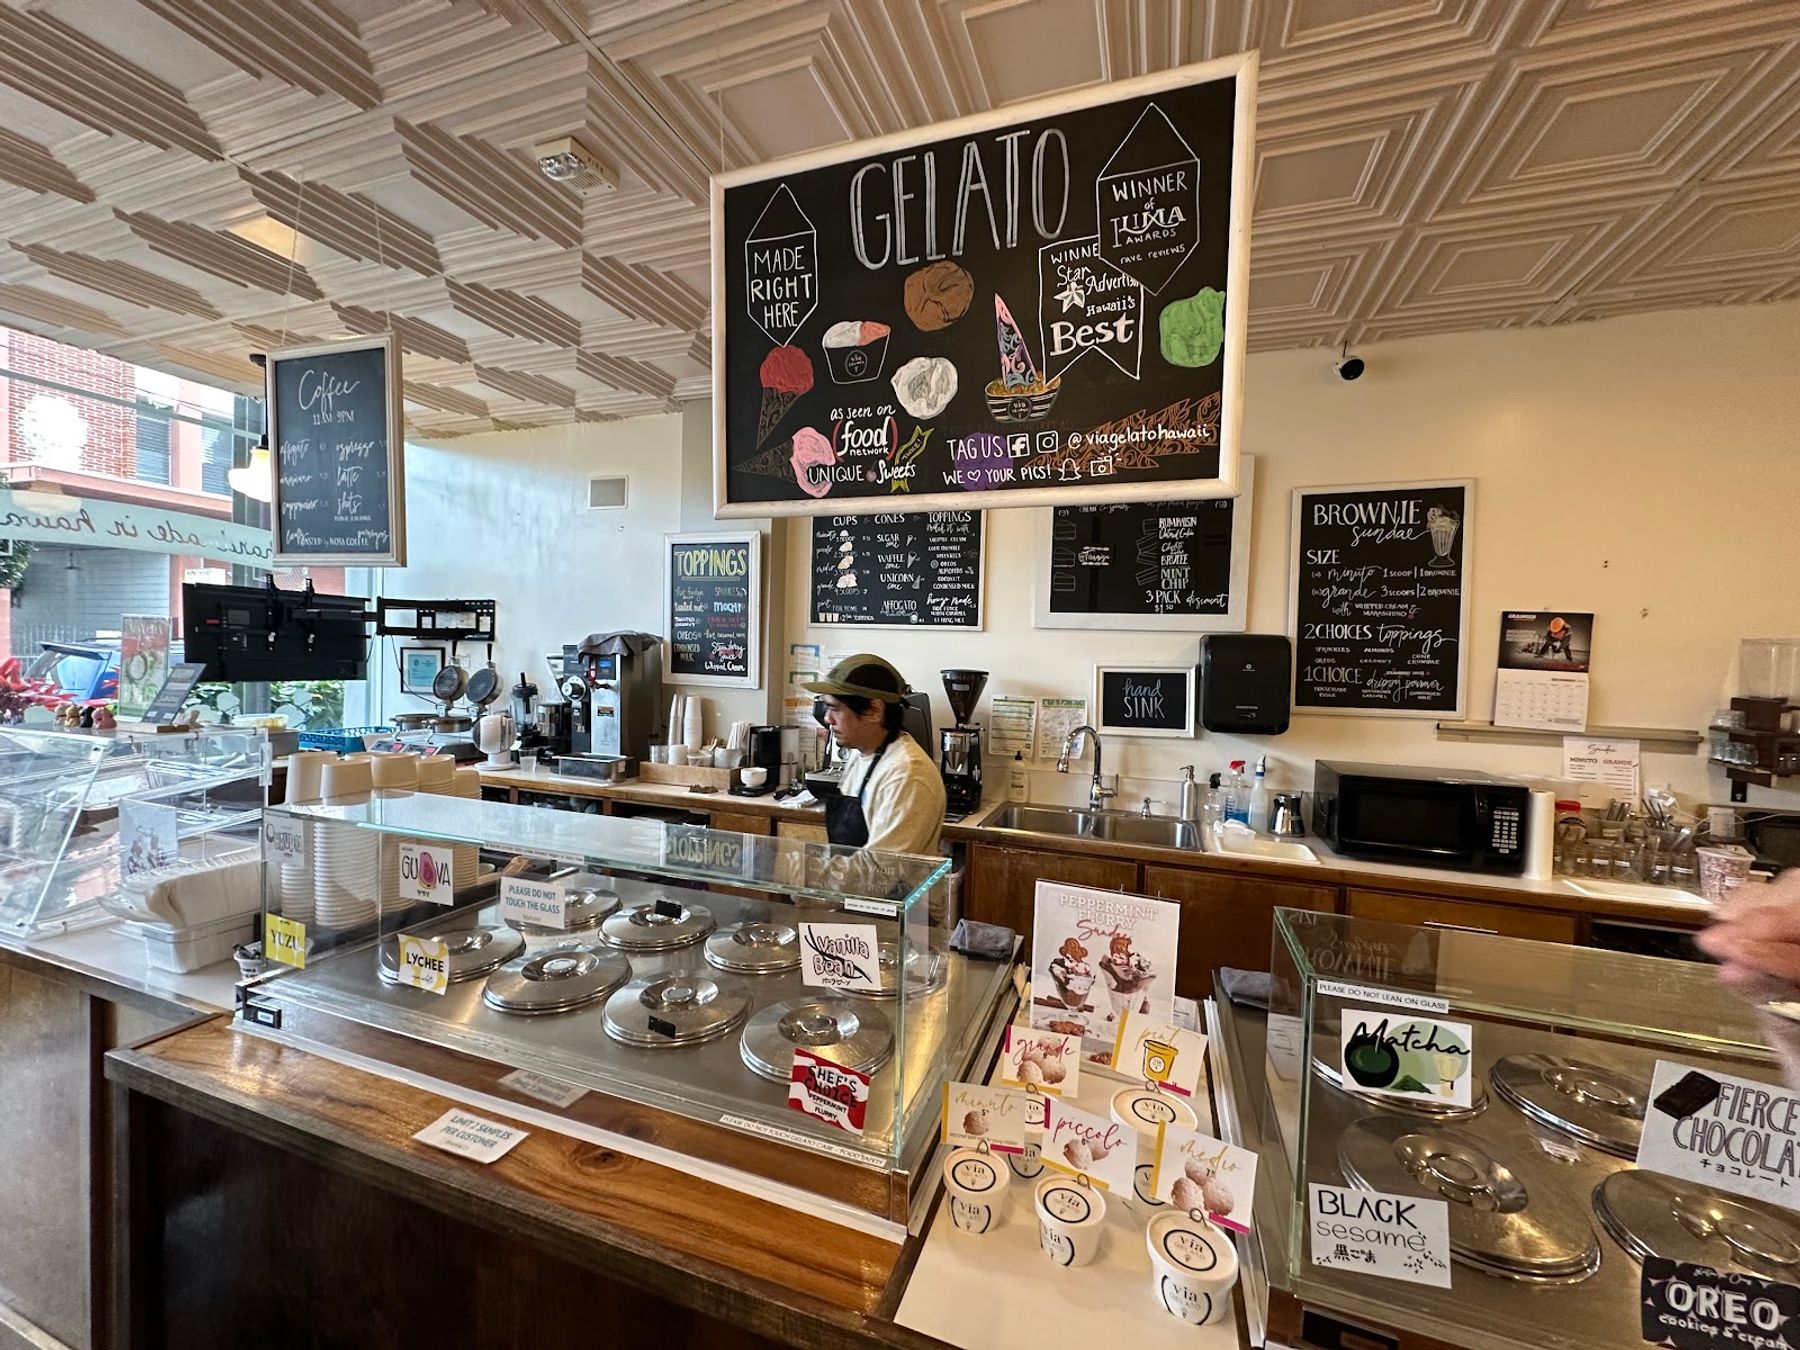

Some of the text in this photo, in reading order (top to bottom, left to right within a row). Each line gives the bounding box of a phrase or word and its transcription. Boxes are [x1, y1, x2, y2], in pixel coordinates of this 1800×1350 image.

[1112, 171, 1188, 202] WINNER
[850, 128, 1071, 270] GELATO
[1144, 197, 1156, 210] of
[1125, 229, 1177, 246] AWARDS
[754, 246, 805, 275] MADE
[1120, 243, 1187, 266] rave reviews
[751, 273, 813, 303] RIGHT
[1056, 265, 1092, 288] Star
[763, 301, 800, 330] HERE
[1085, 294, 1136, 318] Hawaii's
[1049, 312, 1136, 357] Best
[299, 369, 360, 411] Coffee
[830, 404, 897, 421] as seen on
[836, 415, 892, 457] food
[849, 446, 890, 457] network
[946, 438, 978, 461] TAG
[980, 436, 1003, 458] US
[808, 458, 916, 485] UNIQUE Sweets
[942, 463, 1052, 486] WE YOUR PICS!
[833, 510, 972, 527] CUPS CONES TOPPINGS
[1313, 499, 1423, 526] BROWNIE
[1350, 515, 1431, 547] sundae
[673, 548, 748, 577] TOPPINGS
[1306, 549, 1341, 565] SIZE
[1160, 567, 1191, 580] MINT
[1160, 578, 1190, 590] CHIP
[1145, 589, 1154, 604] 3
[1155, 590, 1181, 604] PACK
[1320, 582, 1377, 609] grande
[1332, 602, 1352, 616] with
[1376, 623, 1458, 654] toppings
[1121, 677, 1164, 698] hand
[1122, 695, 1167, 720] SINK
[508, 884, 556, 901] PLEASE DO NOT
[505, 896, 561, 914] TOUCH THE GLASS
[1058, 893, 1160, 922] PEPPERMINT
[1077, 908, 1138, 930] FLURRY
[269, 928, 300, 952] YUZU
[816, 933, 870, 960] Vanilla
[405, 952, 445, 973] LYCHEE
[812, 953, 856, 978] Bean
[1319, 983, 1447, 1010] PLEASE DO NOT LEAN ON GLASS
[1348, 1018, 1472, 1056] Matcha
[1012, 1036, 1077, 1067] grande
[808, 1092, 848, 1114] PEPPERMINT
[814, 1106, 838, 1120] FLURRY
[1713, 1081, 1800, 1137] FIERCE
[440, 1126, 456, 1138] PER
[455, 1129, 498, 1149] CUSTOMER
[450, 1115, 513, 1141] LIMIT 2 SAMPLES
[1051, 1115, 1129, 1151] piccolo
[722, 1115, 884, 1166] PLEASE DO NOT TOUCH GELATO CASE FOOD SAFETY
[1180, 1138, 1243, 1173] medio
[965, 1164, 985, 1175] via
[1700, 1158, 1790, 1188] チョコレート
[959, 1200, 980, 1216] via
[1059, 1192, 1081, 1208] via
[1317, 1189, 1419, 1230] BLACK
[1043, 1227, 1061, 1245] via
[1180, 1234, 1204, 1254] via
[1316, 1219, 1427, 1252] sesame
[1332, 1243, 1376, 1264] 黒ごま
[1171, 1283, 1199, 1303] via
[1665, 1279, 1781, 1332] OREO
[1658, 1313, 1720, 1336] cookies
